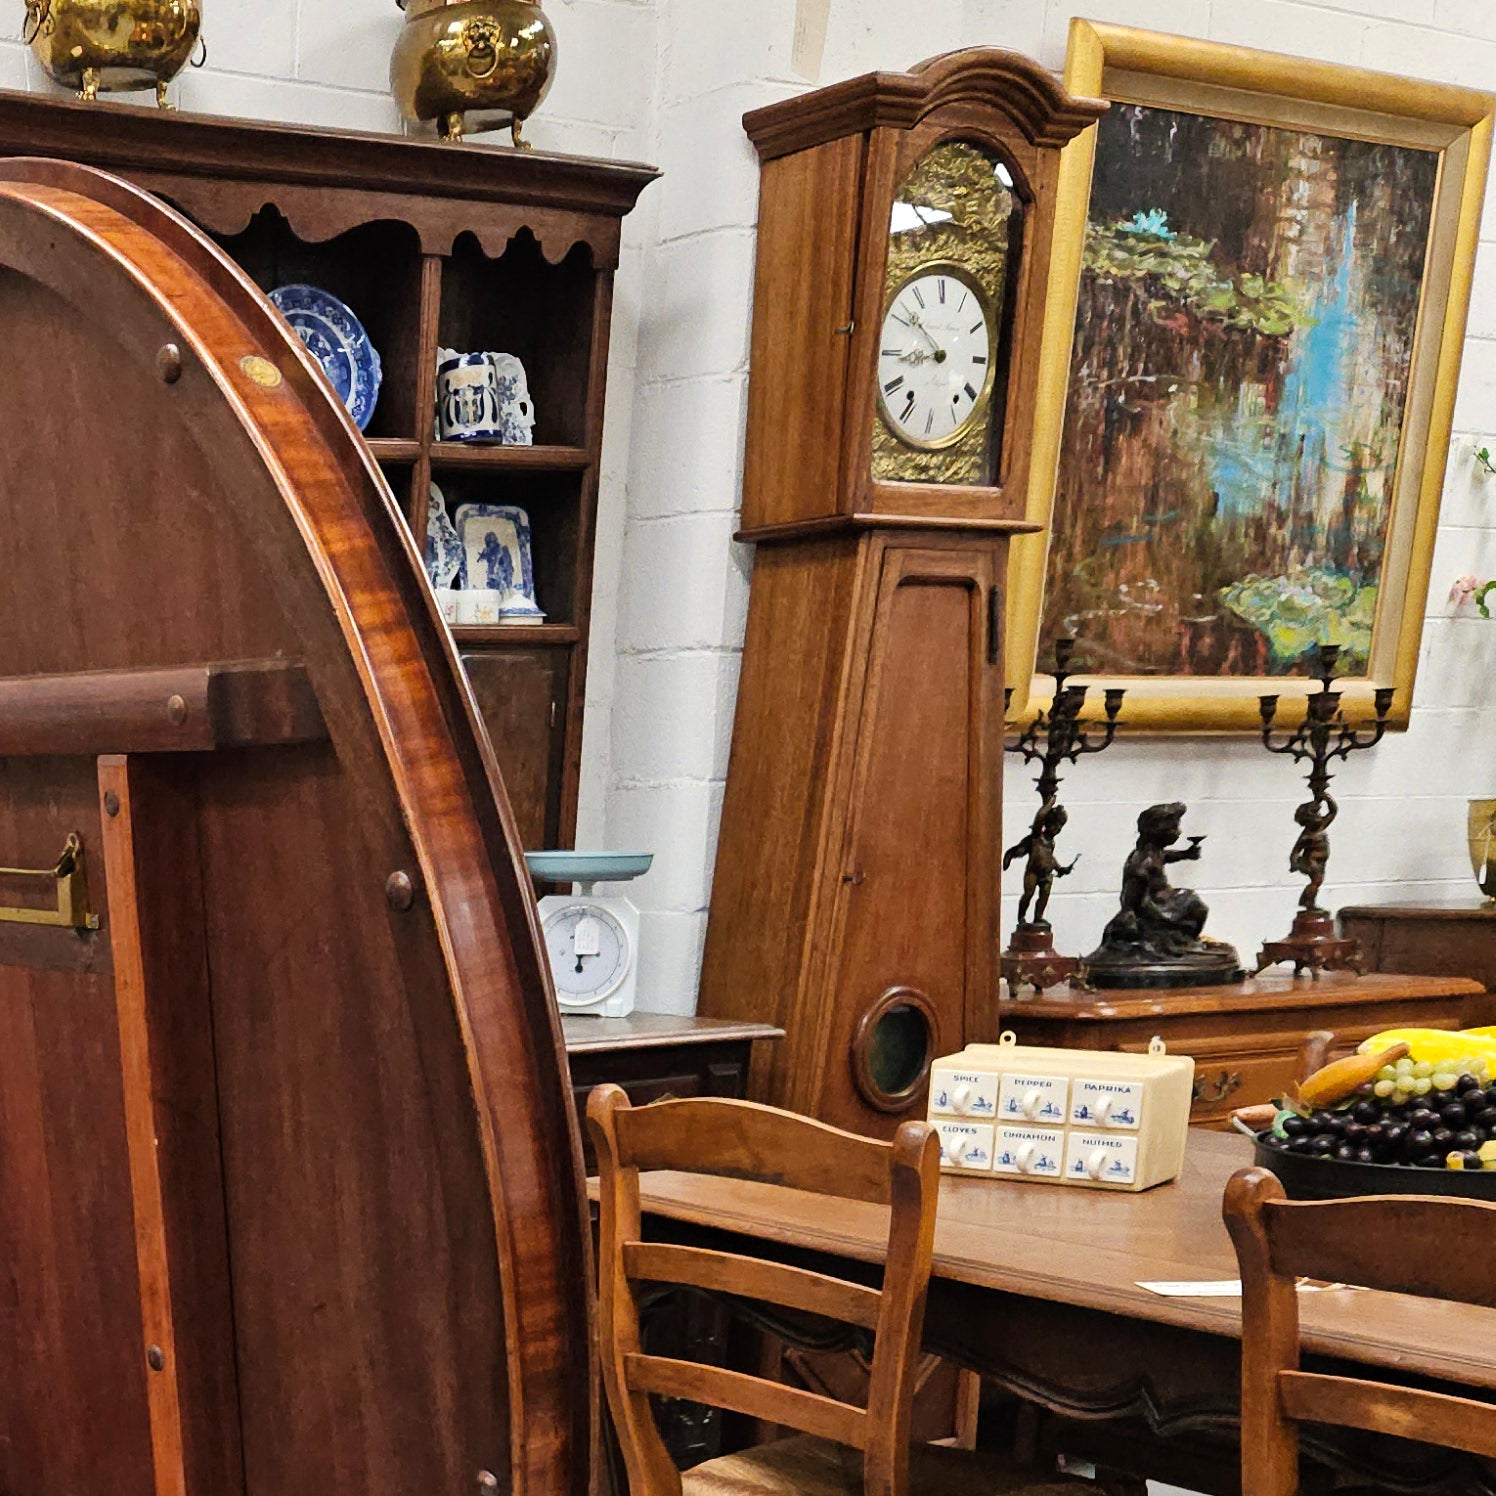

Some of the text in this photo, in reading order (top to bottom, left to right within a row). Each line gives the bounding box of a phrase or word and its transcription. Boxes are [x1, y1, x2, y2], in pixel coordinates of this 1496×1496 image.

[953, 1075, 979, 1083] SPICE
[1014, 1079, 1052, 1088] PEPPER
[1084, 1083, 1131, 1093] PAPRIKA
[942, 1125, 977, 1134] CLOVES
[1003, 1131, 1056, 1141] CINNAMON
[1082, 1139, 1122, 1148] NUTMEG
